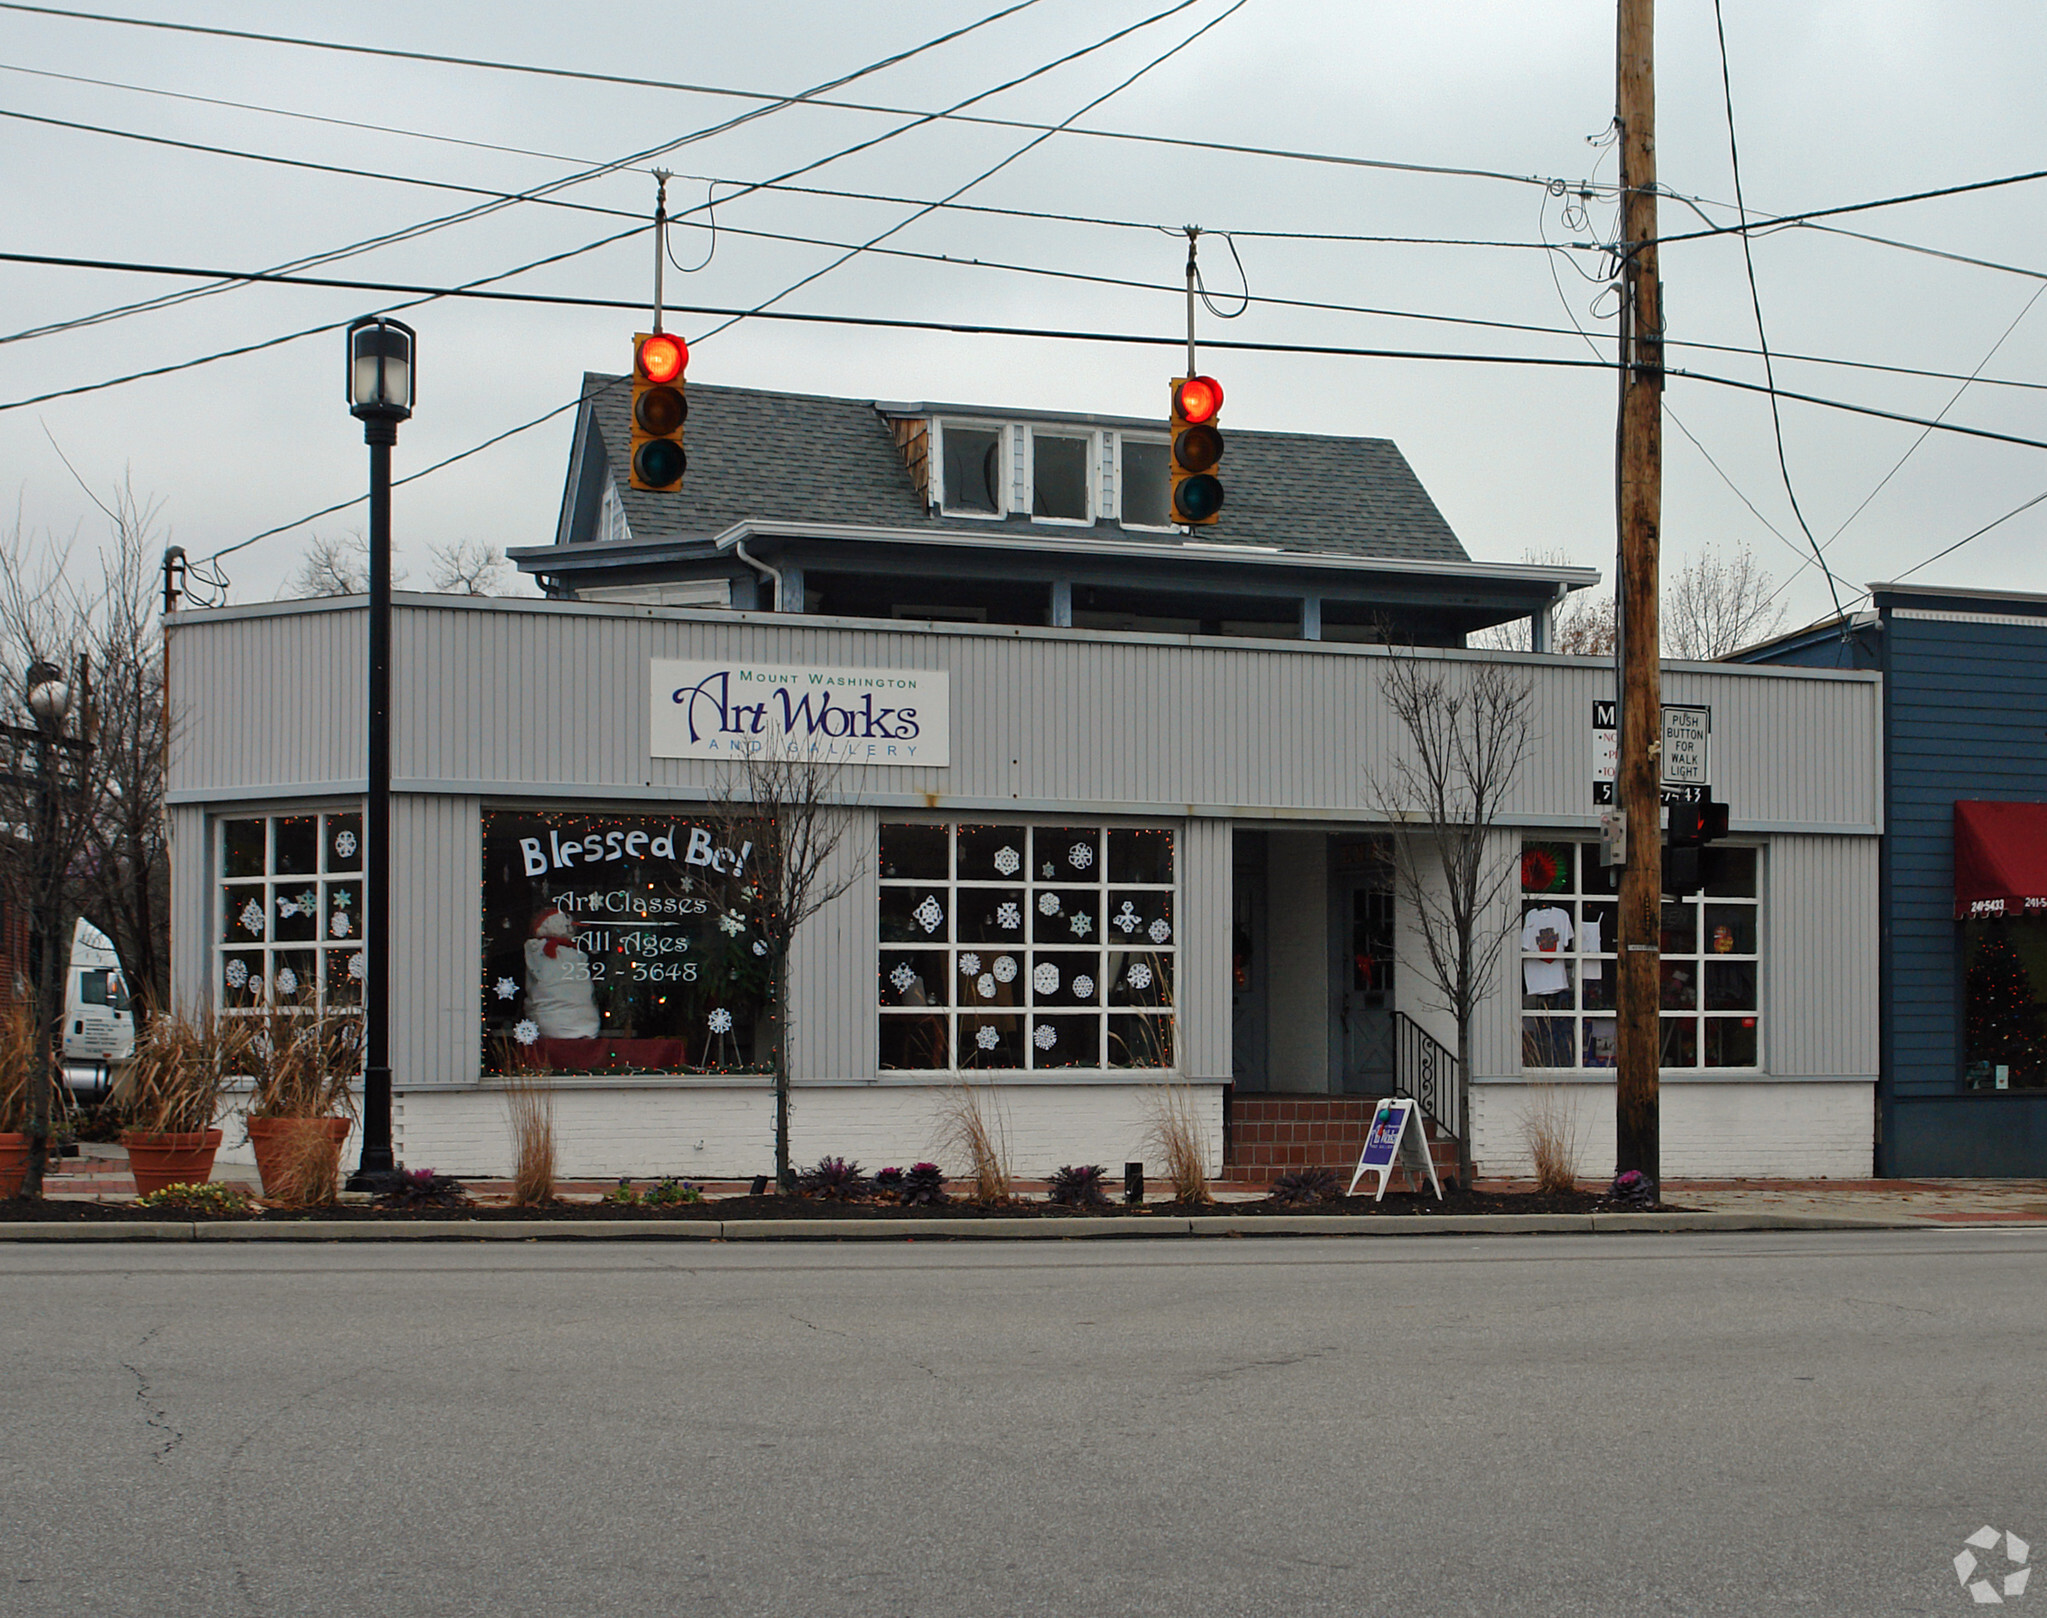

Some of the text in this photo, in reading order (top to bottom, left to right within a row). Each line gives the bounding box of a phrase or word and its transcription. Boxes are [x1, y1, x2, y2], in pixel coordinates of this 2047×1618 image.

[672, 671, 920, 745] Art Works
[1672, 714, 1699, 727] PUSH
[1667, 727, 1704, 740] BUTTON
[709, 739, 918, 757] AND GALLERY
[1676, 740, 1694, 752] FOR
[1671, 753, 1698, 765] WALK
[1671, 765, 1698, 777] LIGHT
[519, 824, 753, 878] Blessed Be!
[552, 890, 708, 916] Art Classes
[571, 930, 689, 958] All Ages
[561, 961, 606, 981] 232
[632, 962, 698, 982] 3648
